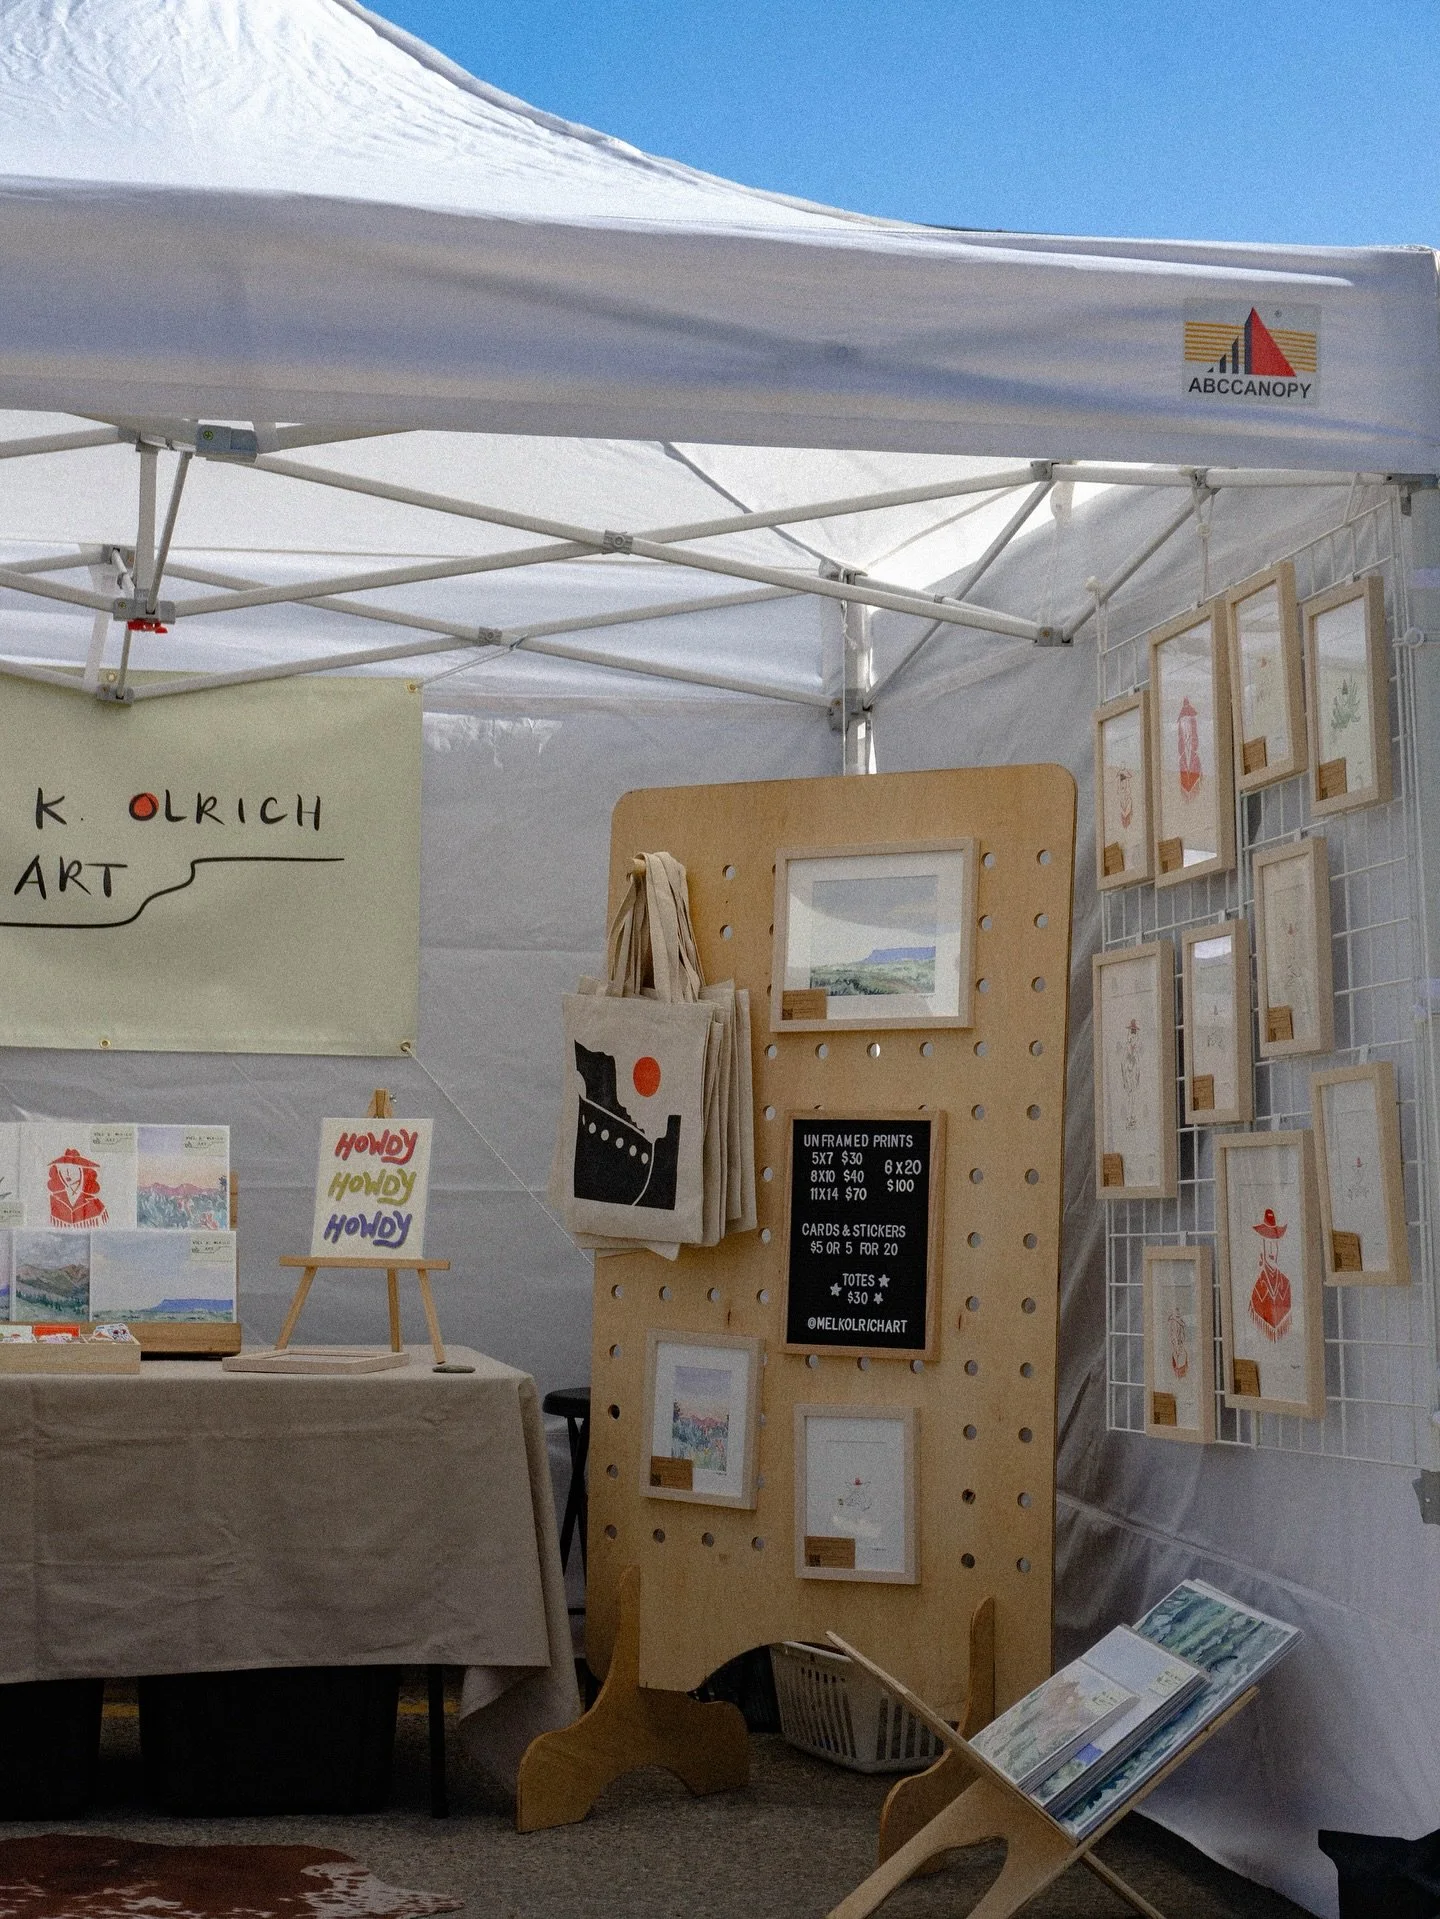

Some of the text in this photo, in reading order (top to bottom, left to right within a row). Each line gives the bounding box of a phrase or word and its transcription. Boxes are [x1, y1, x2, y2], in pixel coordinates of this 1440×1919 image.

[1188, 377, 1312, 399] ABCCANOPY
[129, 790, 320, 831] OLRICH
[14, 855, 128, 900] ART
[335, 1129, 418, 1165] HOWDY
[804, 1134, 913, 1147] UNFRAMED PRINTS
[812, 1151, 862, 1165] 5X7 $30
[811, 1170, 864, 1183] 8X10 $40
[328, 1168, 417, 1206] HOWDY
[887, 1179, 914, 1192] $100
[811, 1186, 867, 1201] 11X14 $70
[324, 1210, 413, 1248] HOWDY
[802, 1223, 905, 1237] CARDS & STICKERS
[811, 1241, 898, 1255] $5 OR 5 FOR 20
[843, 1273, 875, 1286] TOTES
[848, 1291, 868, 1304] $30
[808, 1317, 907, 1333] @MELKOLRICHART
